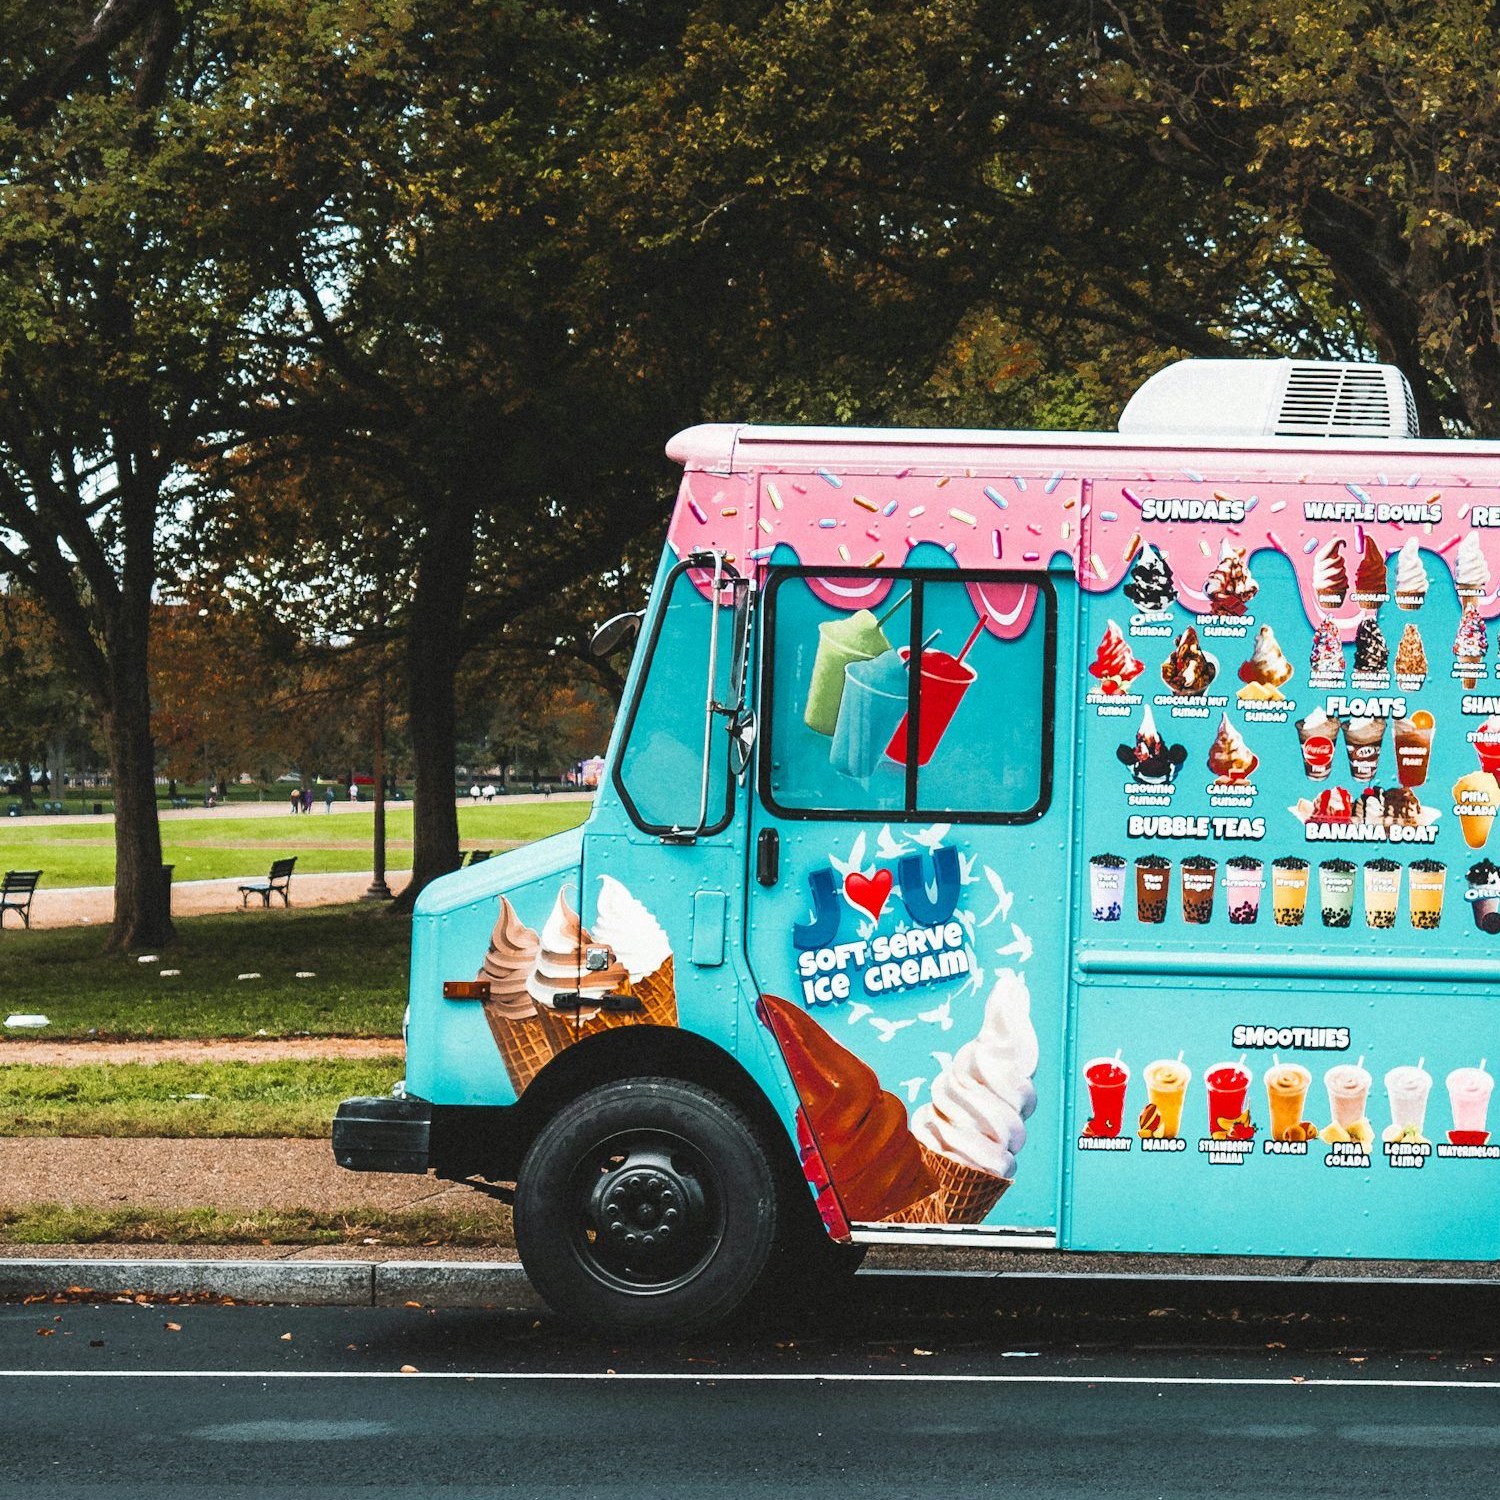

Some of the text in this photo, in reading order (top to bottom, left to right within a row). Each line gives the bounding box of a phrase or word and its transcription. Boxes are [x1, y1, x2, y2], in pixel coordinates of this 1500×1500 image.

[1142, 499, 1245, 521] SUNDAES
[1304, 502, 1442, 523] WAFFLE BOWLS
[1197, 615, 1255, 626] HOT FUDGE
[1130, 626, 1172, 637] SUNDAE
[1204, 627, 1247, 638] SUNDAE
[1086, 694, 1143, 705] STRAWBERRY
[1154, 696, 1228, 706] CHOCOLATE NUT
[1237, 699, 1296, 711] PINEAPPLE
[1098, 706, 1131, 716] SUNDAE
[1171, 708, 1209, 718] SUNDAE
[1326, 696, 1406, 718] FLOATS
[1245, 712, 1288, 722] SUNDAE
[1124, 783, 1175, 794] BROWNIE
[1206, 785, 1258, 795] CARAMEL
[1128, 795, 1171, 806] SUNDAE
[1210, 796, 1253, 807] SUNDAE
[1453, 805, 1497, 816] COLADA
[1128, 815, 1266, 840] BUBBLE TEAS
[1304, 823, 1439, 844] BANANA BOAT
[897, 845, 962, 926] U
[799, 940, 868, 978] SOFT
[1232, 1026, 1350, 1050] SMOOTHIES
[1078, 1137, 1133, 1151] STRAWBERRY
[1142, 1138, 1187, 1152] MANGO
[1198, 1139, 1255, 1153] STRAWBERRY
[1263, 1140, 1308, 1154] PEACH
[1333, 1142, 1363, 1155] PINA
[1437, 1144, 1500, 1159] WATERMELON
[1208, 1152, 1244, 1165] BANANA
[1324, 1154, 1371, 1168] COLADA
